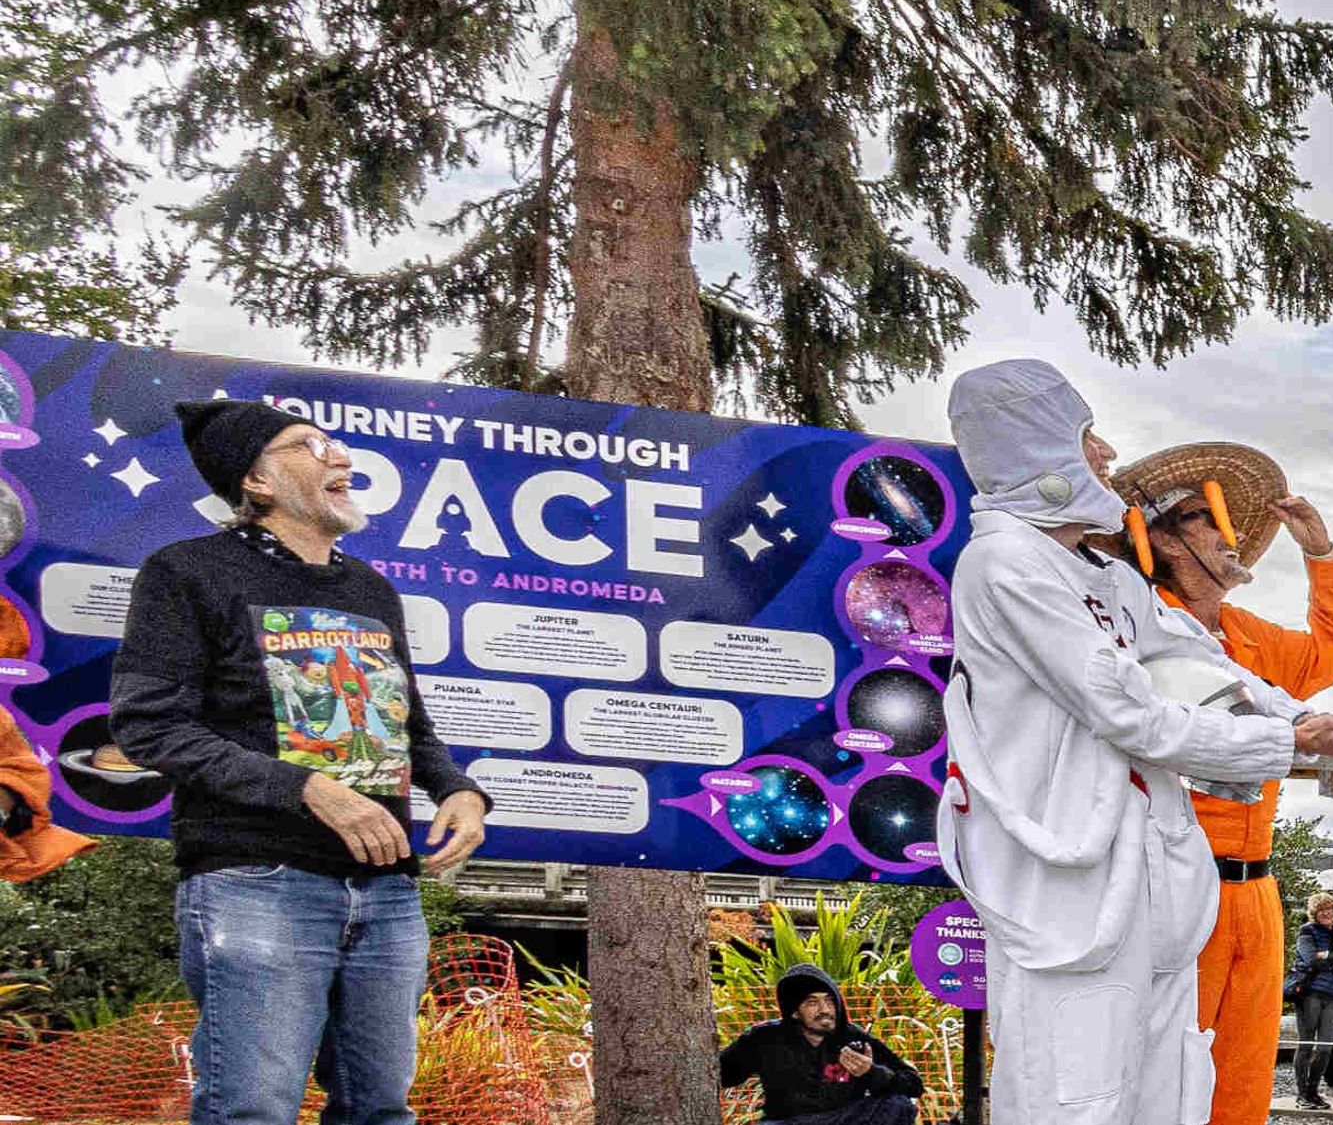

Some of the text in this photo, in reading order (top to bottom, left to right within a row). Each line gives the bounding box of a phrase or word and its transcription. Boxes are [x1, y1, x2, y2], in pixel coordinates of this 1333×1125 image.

[474, 419, 689, 471] THROUGH
[193, 448, 704, 578] PACE
[371, 560, 666, 604] RTH TO ANDROMEDA
[533, 614, 579, 626] JUPITER
[264, 630, 392, 652] CARROTLAND
[727, 633, 769, 644] SATURN
[434, 684, 482, 695] PUANGA
[606, 698, 702, 713] OMEGA CENTAURI
[522, 768, 594, 781] ANDROMEDA
[935, 926, 987, 940] THANKS
